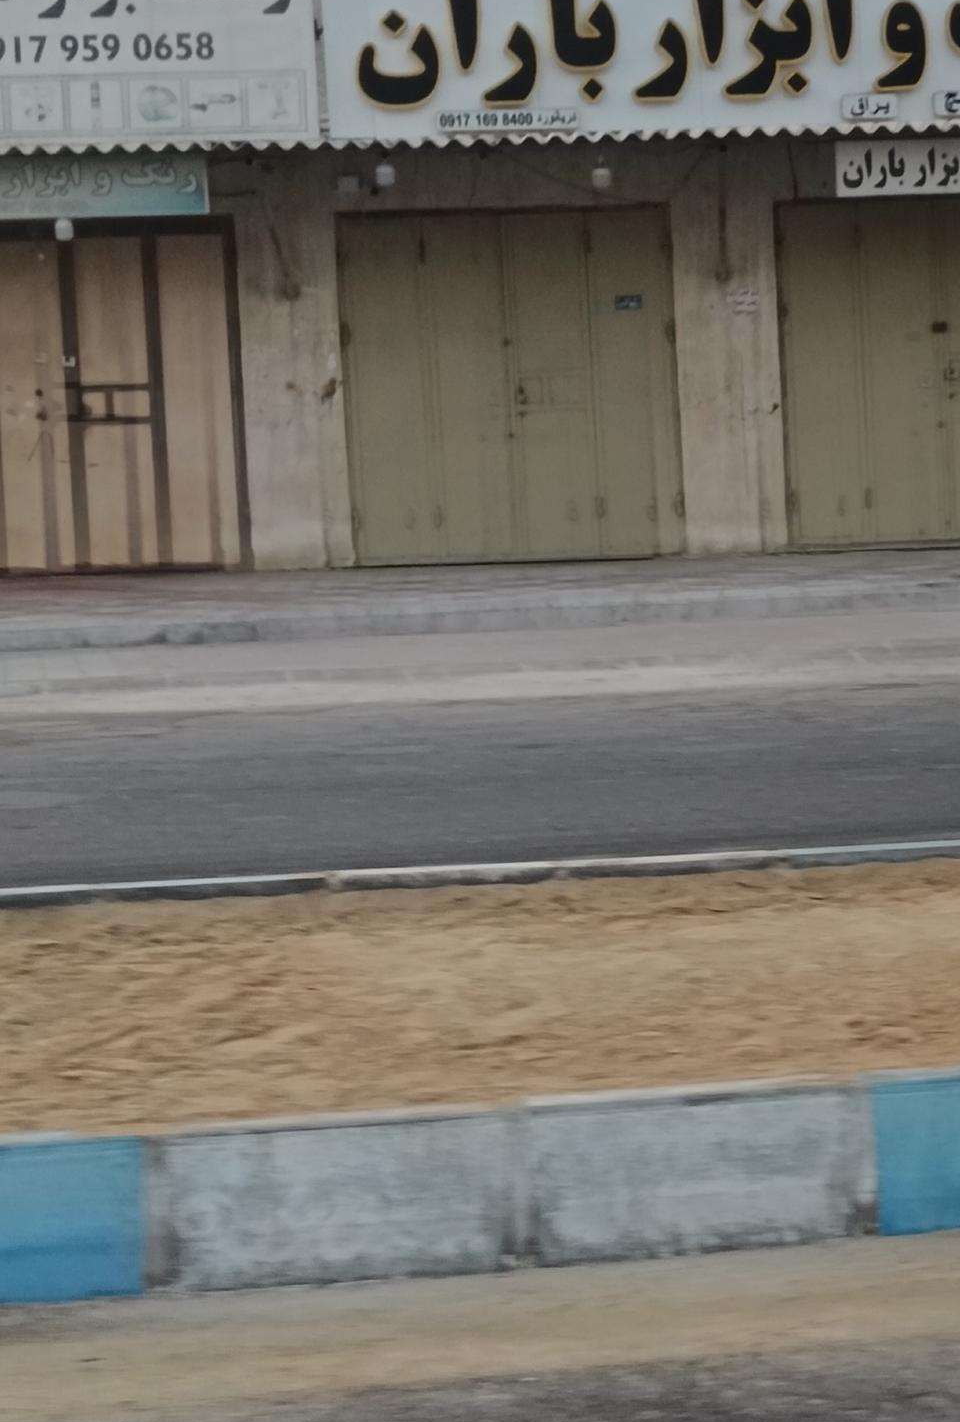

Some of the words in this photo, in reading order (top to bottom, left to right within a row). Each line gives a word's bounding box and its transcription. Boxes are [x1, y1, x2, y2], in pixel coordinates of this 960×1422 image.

[0, 35, 47, 63] 17
[60, 33, 120, 62] 959
[133, 32, 215, 61] 0658
[875, 0, 926, 90] و
[440, 113, 470, 127] 0917
[91, 170, 112, 196] و
[843, 147, 905, 189] باران
